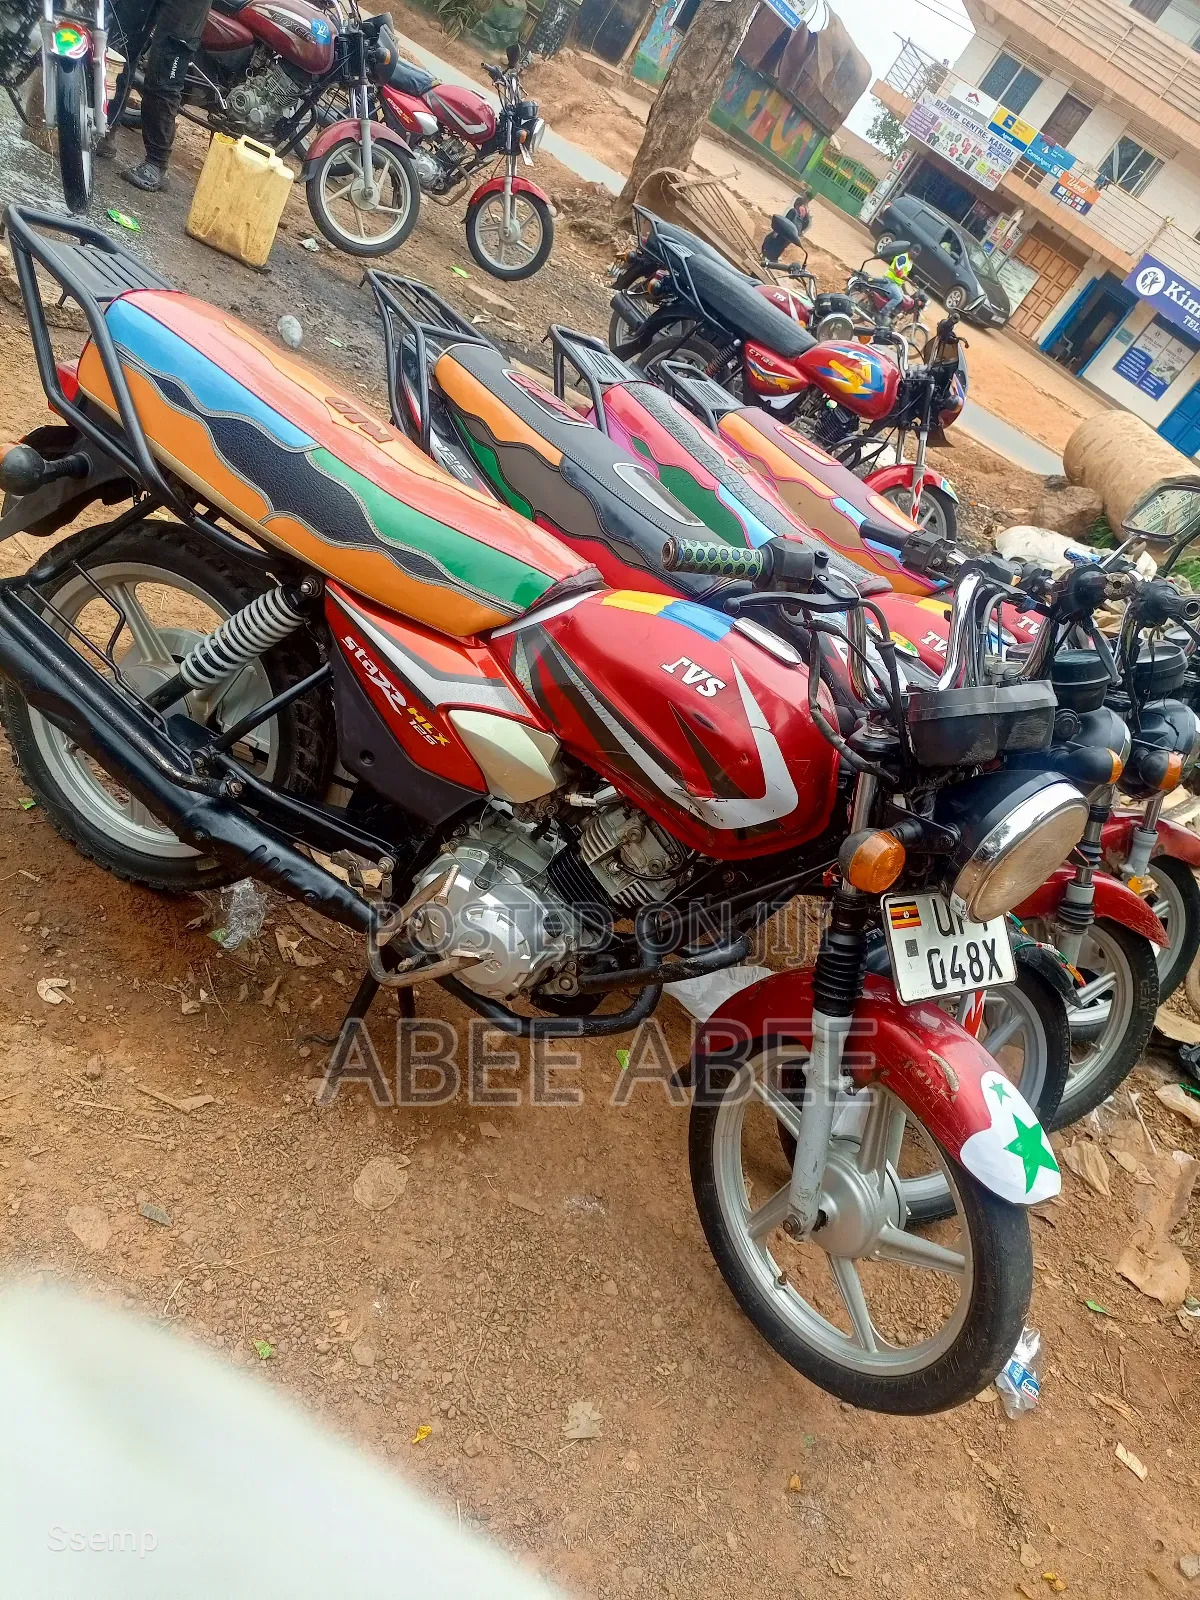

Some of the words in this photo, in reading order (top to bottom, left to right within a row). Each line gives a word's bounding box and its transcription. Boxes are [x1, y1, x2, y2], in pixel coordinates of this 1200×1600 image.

[170, 56, 180, 80] CHANEL
[934, 99, 960, 119] BIZHUB
[988, 136, 1014, 157] KASUBI
[773, 291, 787, 304] TVS
[1016, 615, 1041, 635] TV
[920, 630, 948, 658] TV
[407, 707, 450, 747] HLX
[409, 720, 438, 746] 125
[926, 938, 1004, 990] 048X
